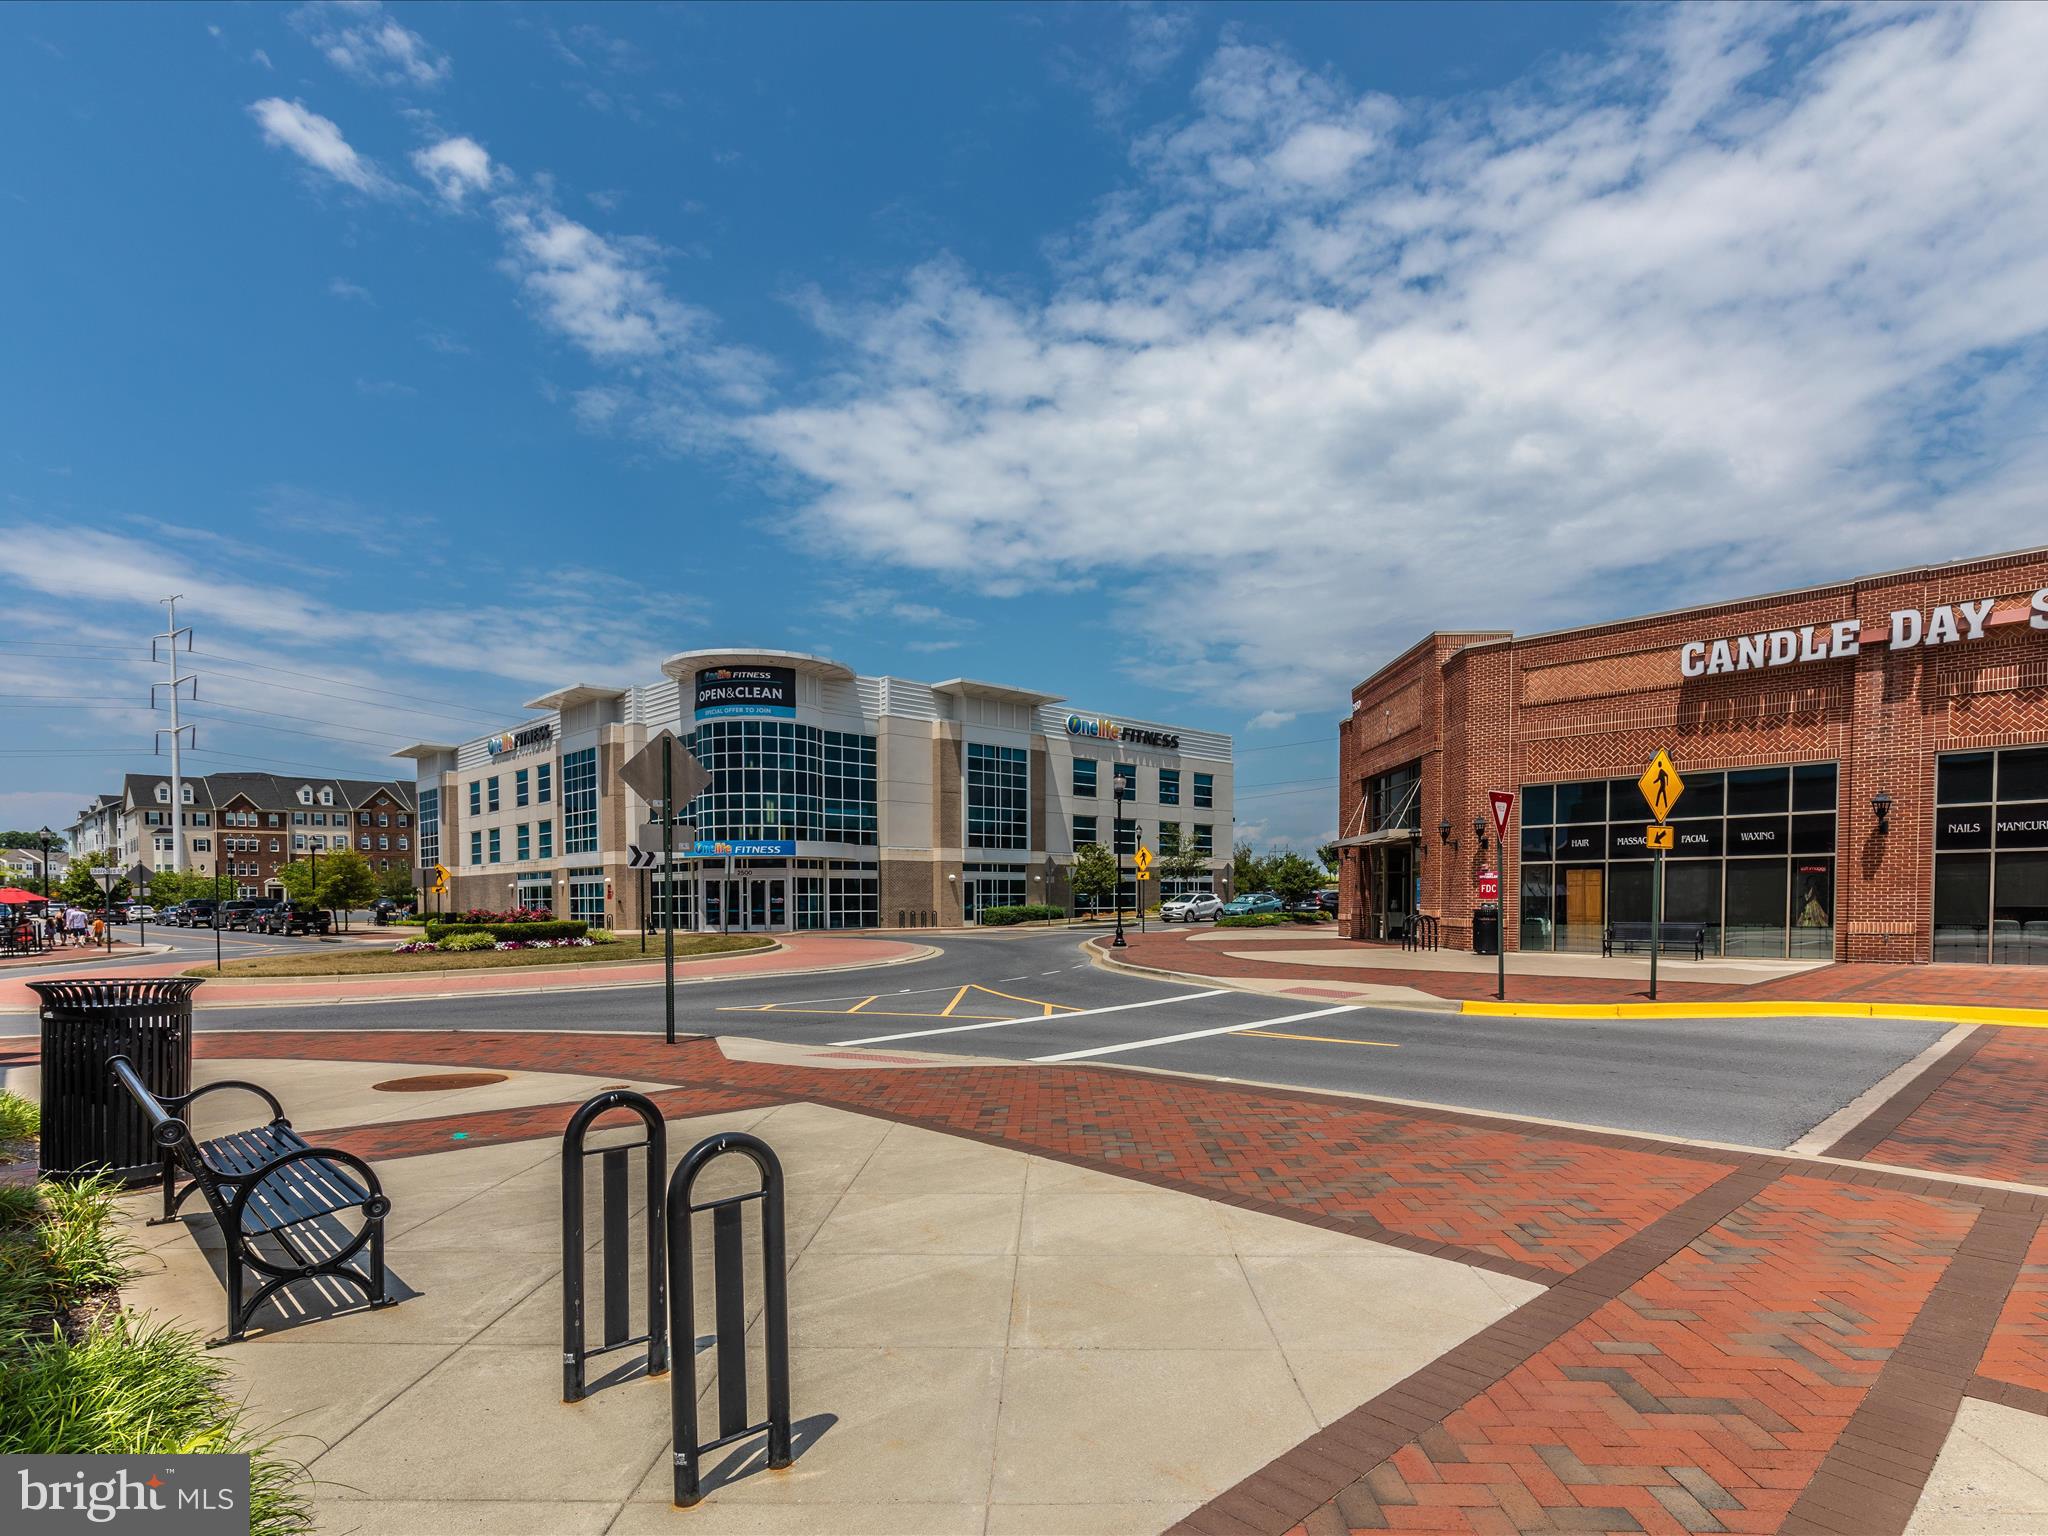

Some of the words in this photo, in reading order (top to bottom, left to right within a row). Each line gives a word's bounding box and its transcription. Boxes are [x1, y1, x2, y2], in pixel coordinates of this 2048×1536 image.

[1681, 619, 1861, 677] CANDLE
[1888, 599, 1995, 651] DAY
[732, 671, 771, 679] FITNESS
[699, 686, 783, 702] OPEN&CLEAN
[704, 708, 723, 716] SPECIAL
[514, 724, 550, 748] FITNESS
[1121, 727, 1180, 749] FITNESS
[1571, 839, 1589, 848] HAIR
[1681, 834, 1709, 843] FACIAL
[1740, 831, 1775, 841] WAXING
[1948, 823, 1980, 833] NAILS
[1997, 820, 2048, 832] MANICUR
[734, 845, 781, 854] FITNESS
[1481, 884, 1497, 893] FDC
